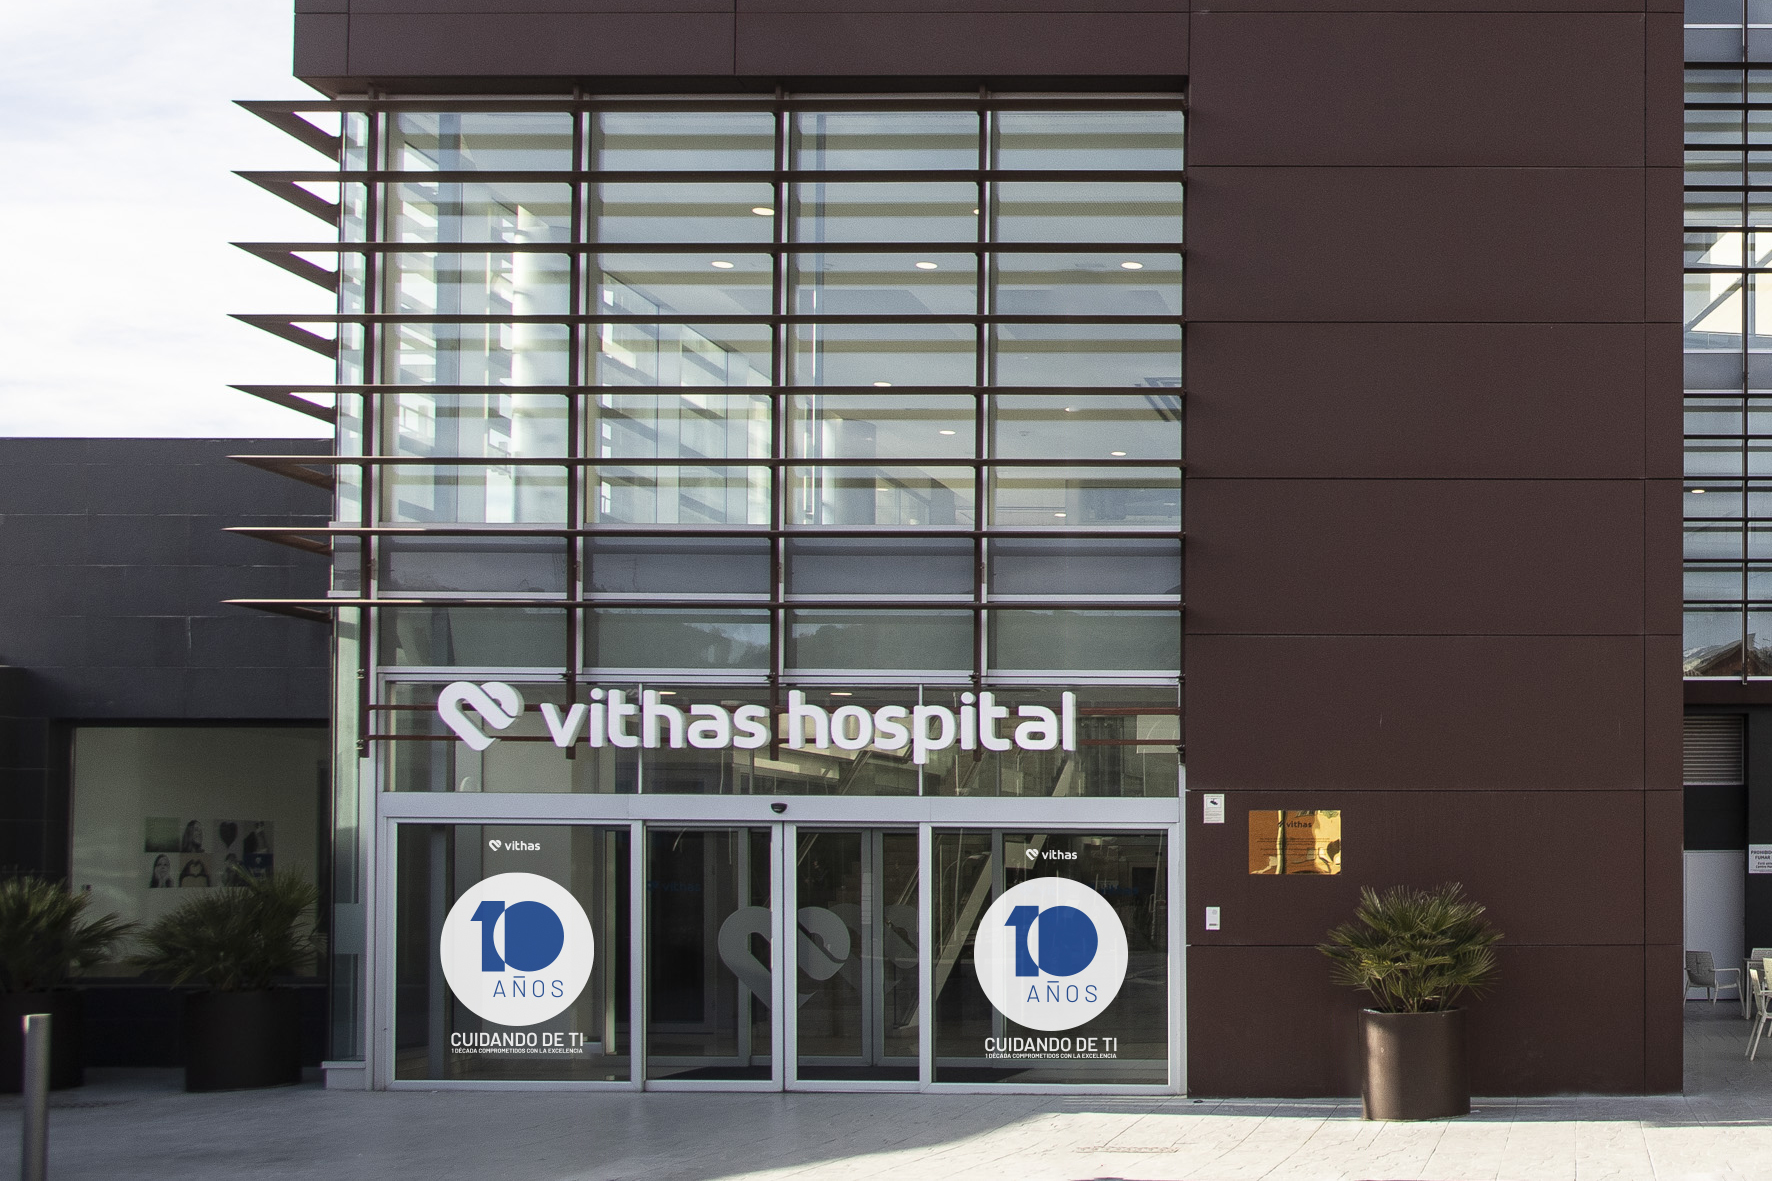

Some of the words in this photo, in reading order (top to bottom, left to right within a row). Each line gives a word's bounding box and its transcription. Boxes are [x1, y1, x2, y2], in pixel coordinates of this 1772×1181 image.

[540, 687, 771, 749] vithas
[788, 689, 1076, 765] hospital
[1286, 820, 1313, 828] vithas
[504, 840, 541, 851] vithas
[1041, 849, 1078, 860] vithas
[470, 900, 565, 972] 10
[1004, 905, 1099, 977] 10
[493, 975, 564, 998] AÑOS
[1026, 980, 1098, 1003] AÑOS
[450, 1032, 538, 1047] CUIDANDO
[542, 1032, 564, 1047] DE
[568, 1032, 584, 1047] TI
[984, 1037, 1072, 1052] CUIDANDO
[1076, 1037, 1098, 1052] DE
[1102, 1037, 1118, 1052] TI
